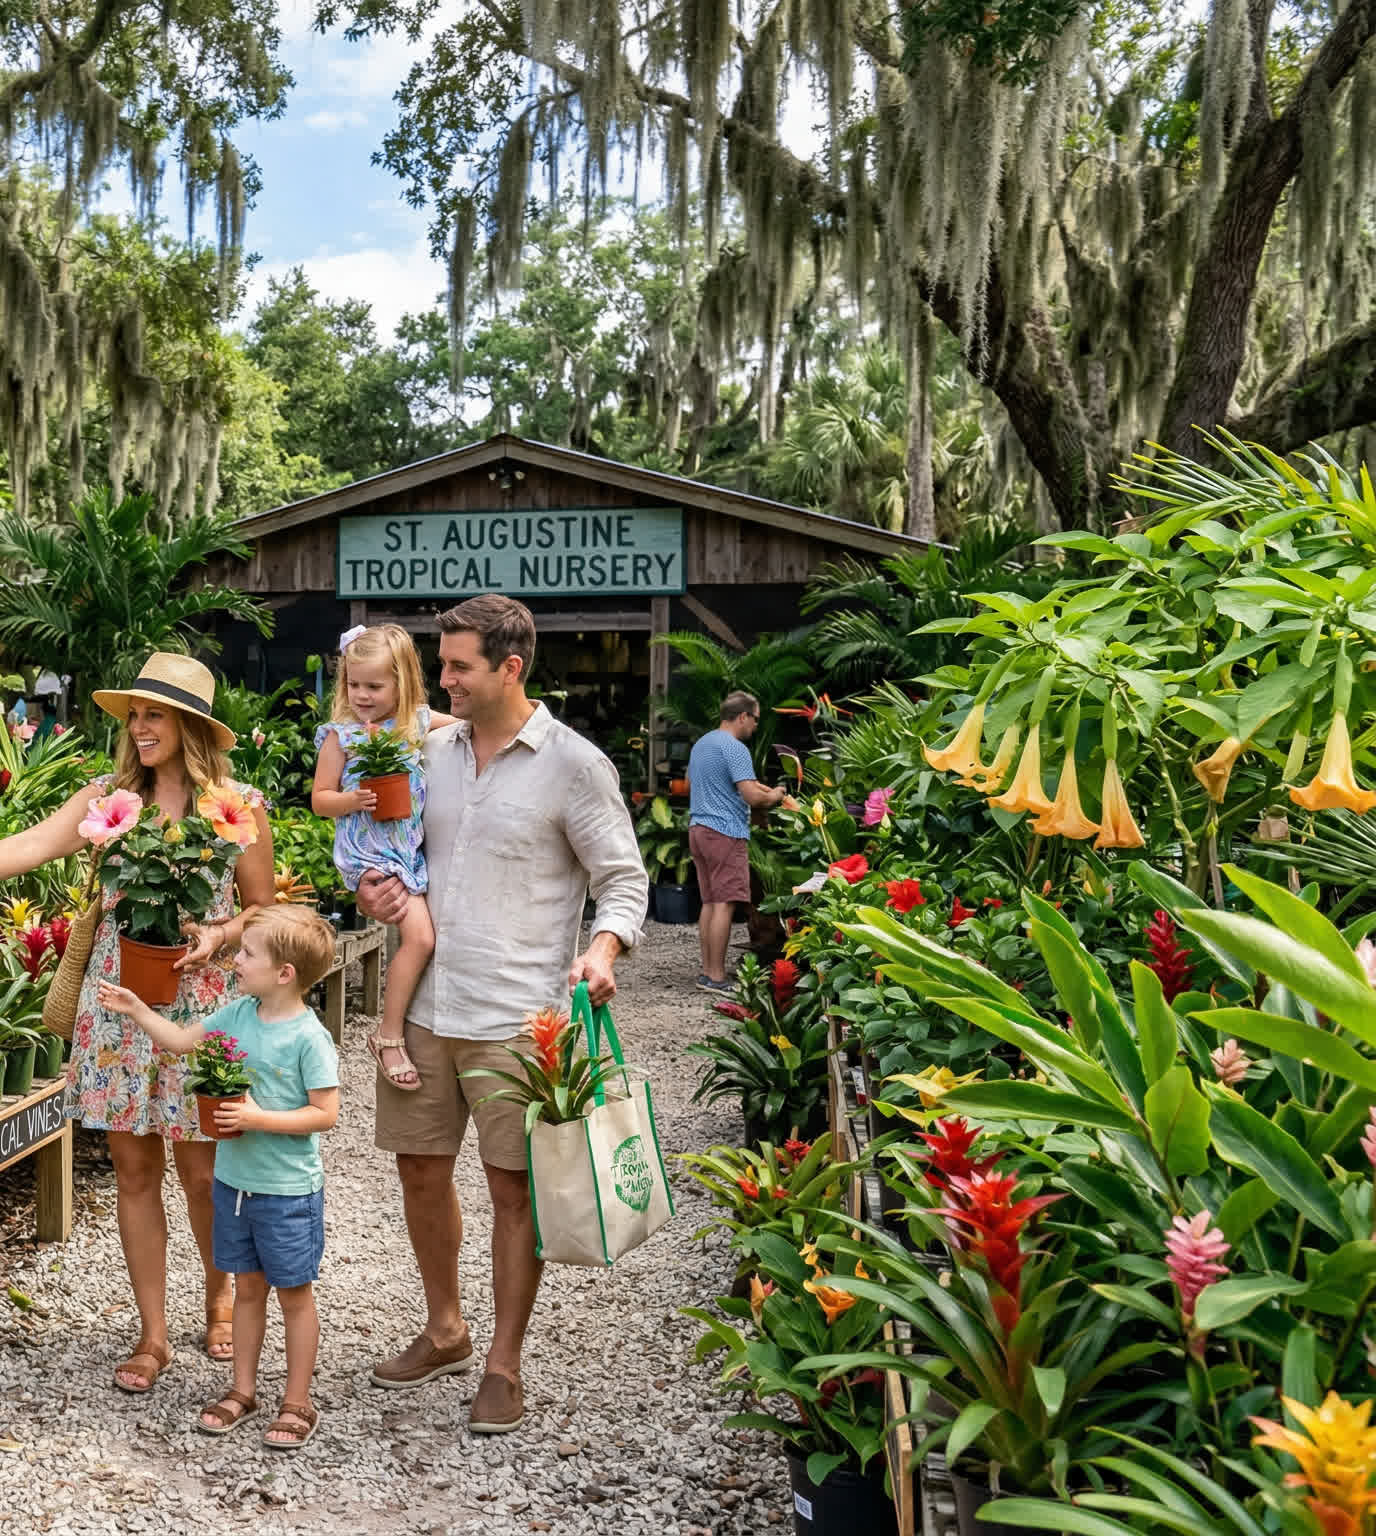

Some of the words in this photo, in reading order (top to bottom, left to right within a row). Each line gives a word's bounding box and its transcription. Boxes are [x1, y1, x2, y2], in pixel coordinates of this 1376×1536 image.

[384, 521, 428, 552] ST.
[442, 515, 635, 551] AUGUSTINE
[345, 556, 502, 591] TROPICAL
[519, 552, 676, 588] NURSERY
[26, 1095, 62, 1141] VINES
